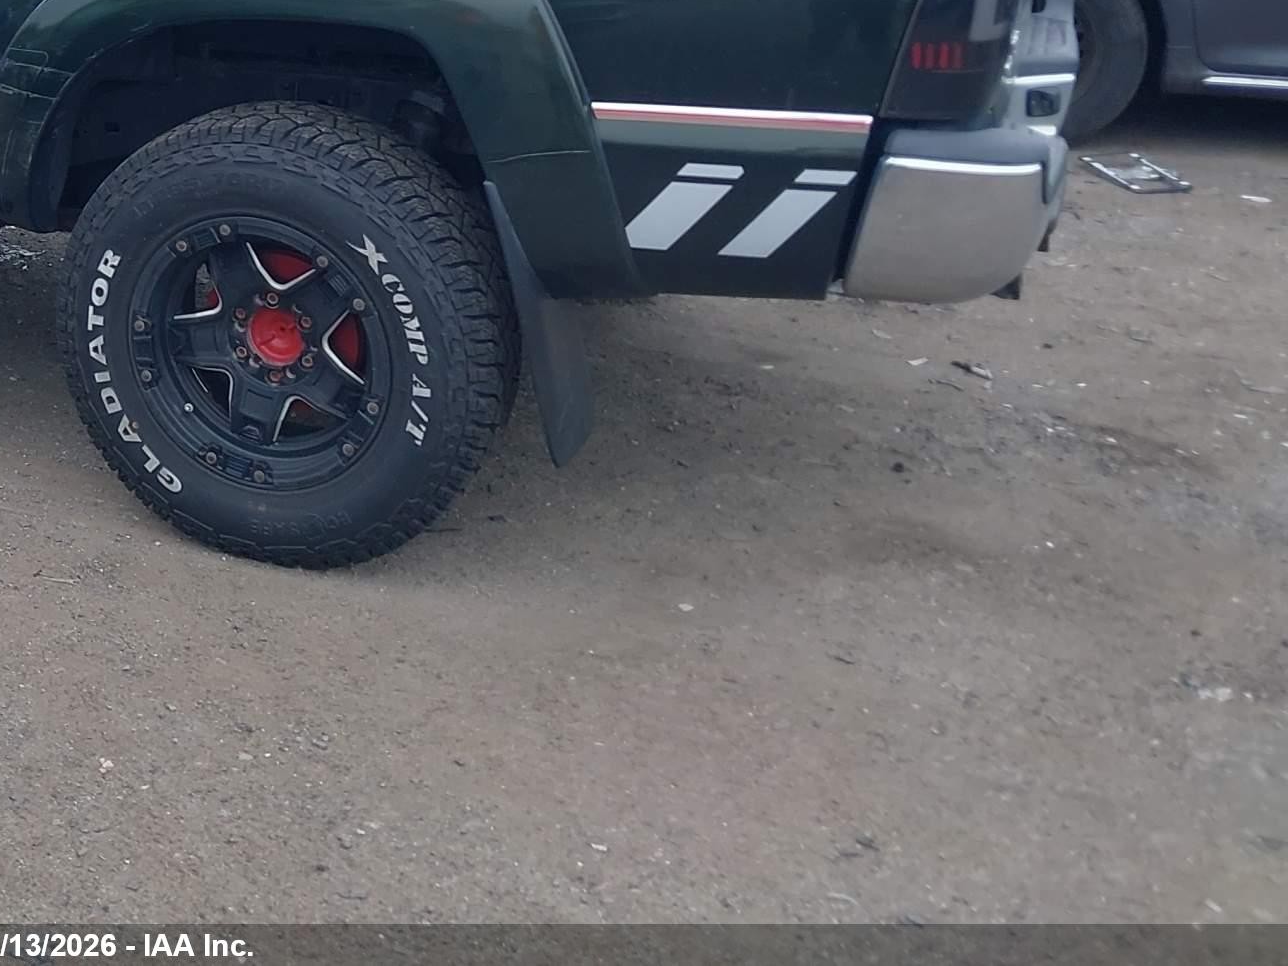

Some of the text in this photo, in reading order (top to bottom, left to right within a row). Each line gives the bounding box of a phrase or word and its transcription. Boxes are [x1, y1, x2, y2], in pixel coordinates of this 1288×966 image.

[87, 249, 183, 493] GLADIATOR
[346, 234, 432, 447] X COMP A/T
